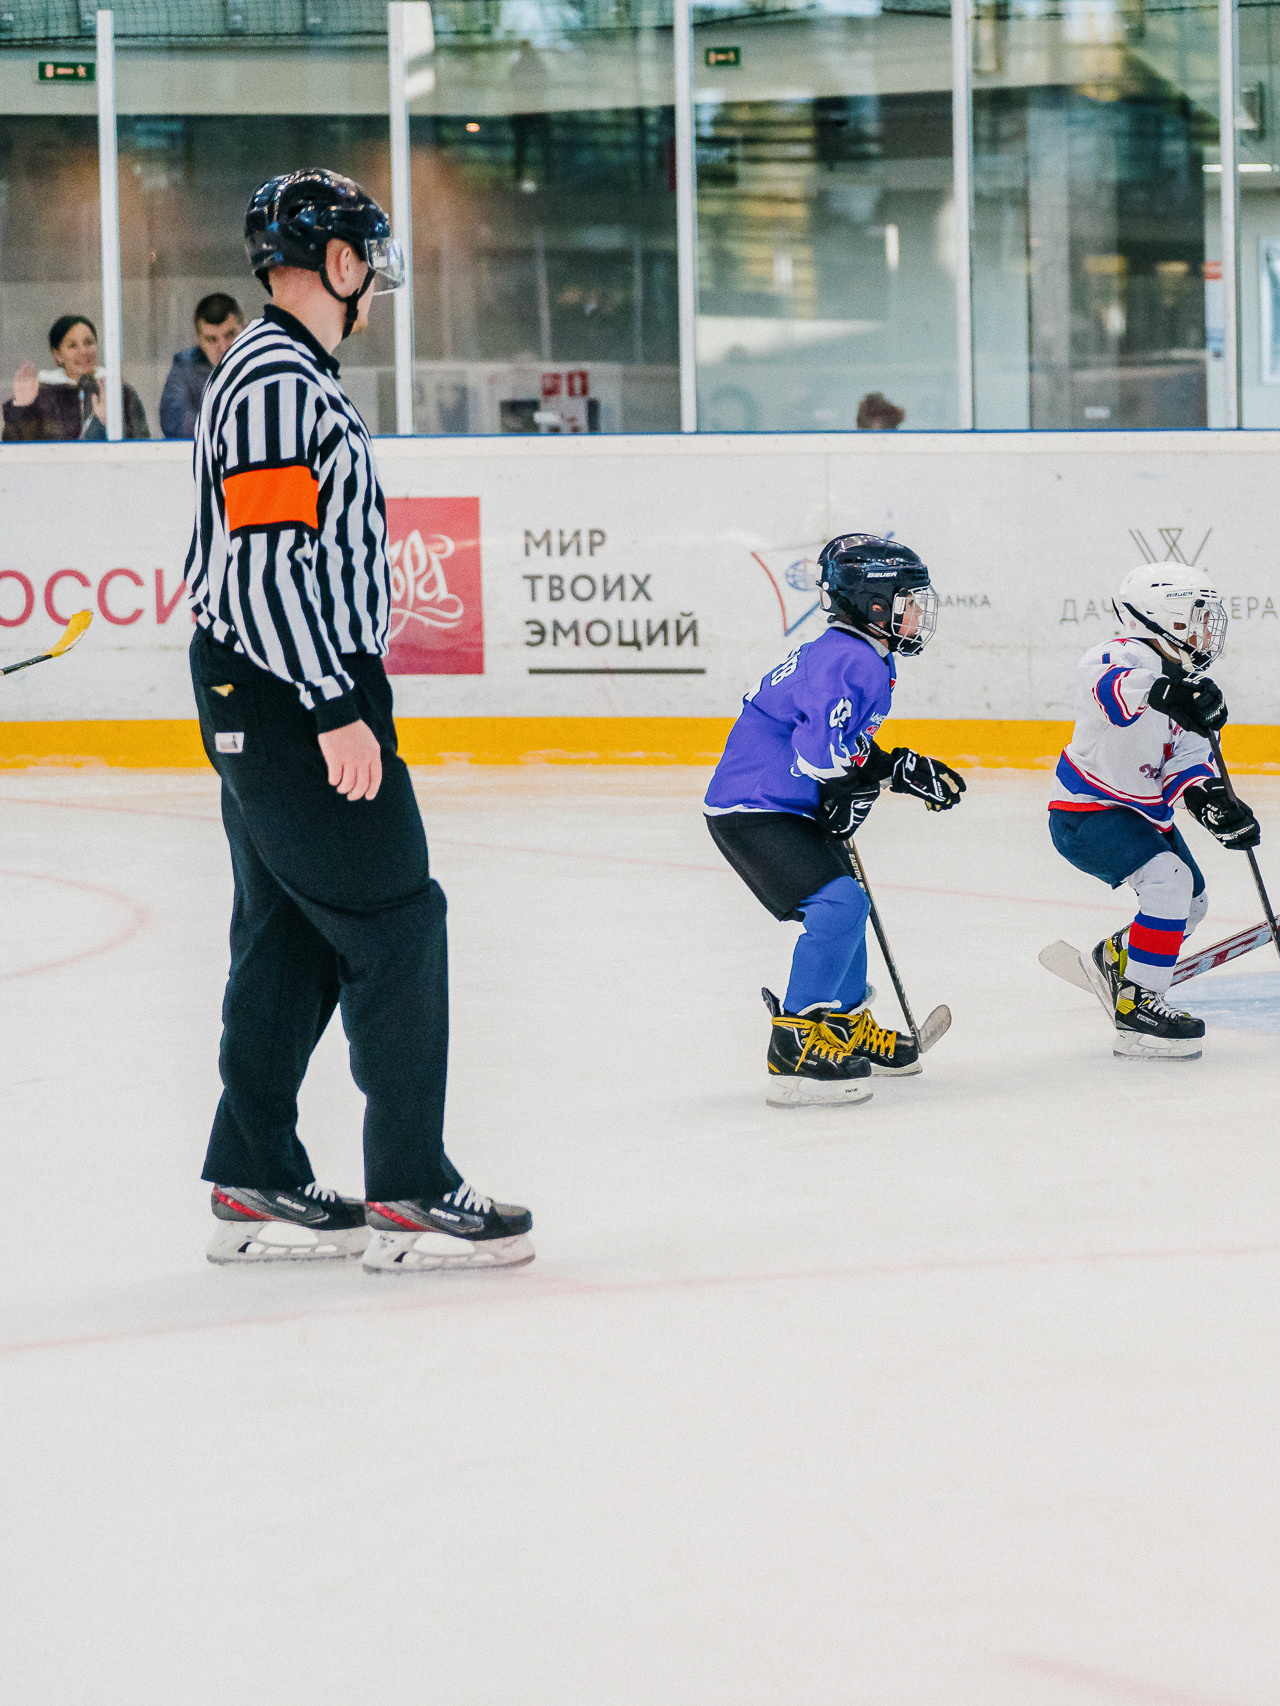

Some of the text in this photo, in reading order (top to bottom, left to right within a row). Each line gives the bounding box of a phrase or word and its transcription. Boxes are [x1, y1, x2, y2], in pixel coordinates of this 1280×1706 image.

[524, 528, 606, 557] МИР
[522, 573, 653, 602] ТВОИХ
[1059, 596, 1279, 625] ДАЧ ЕРА
[525, 611, 699, 651] ЭМОЦИЙ
